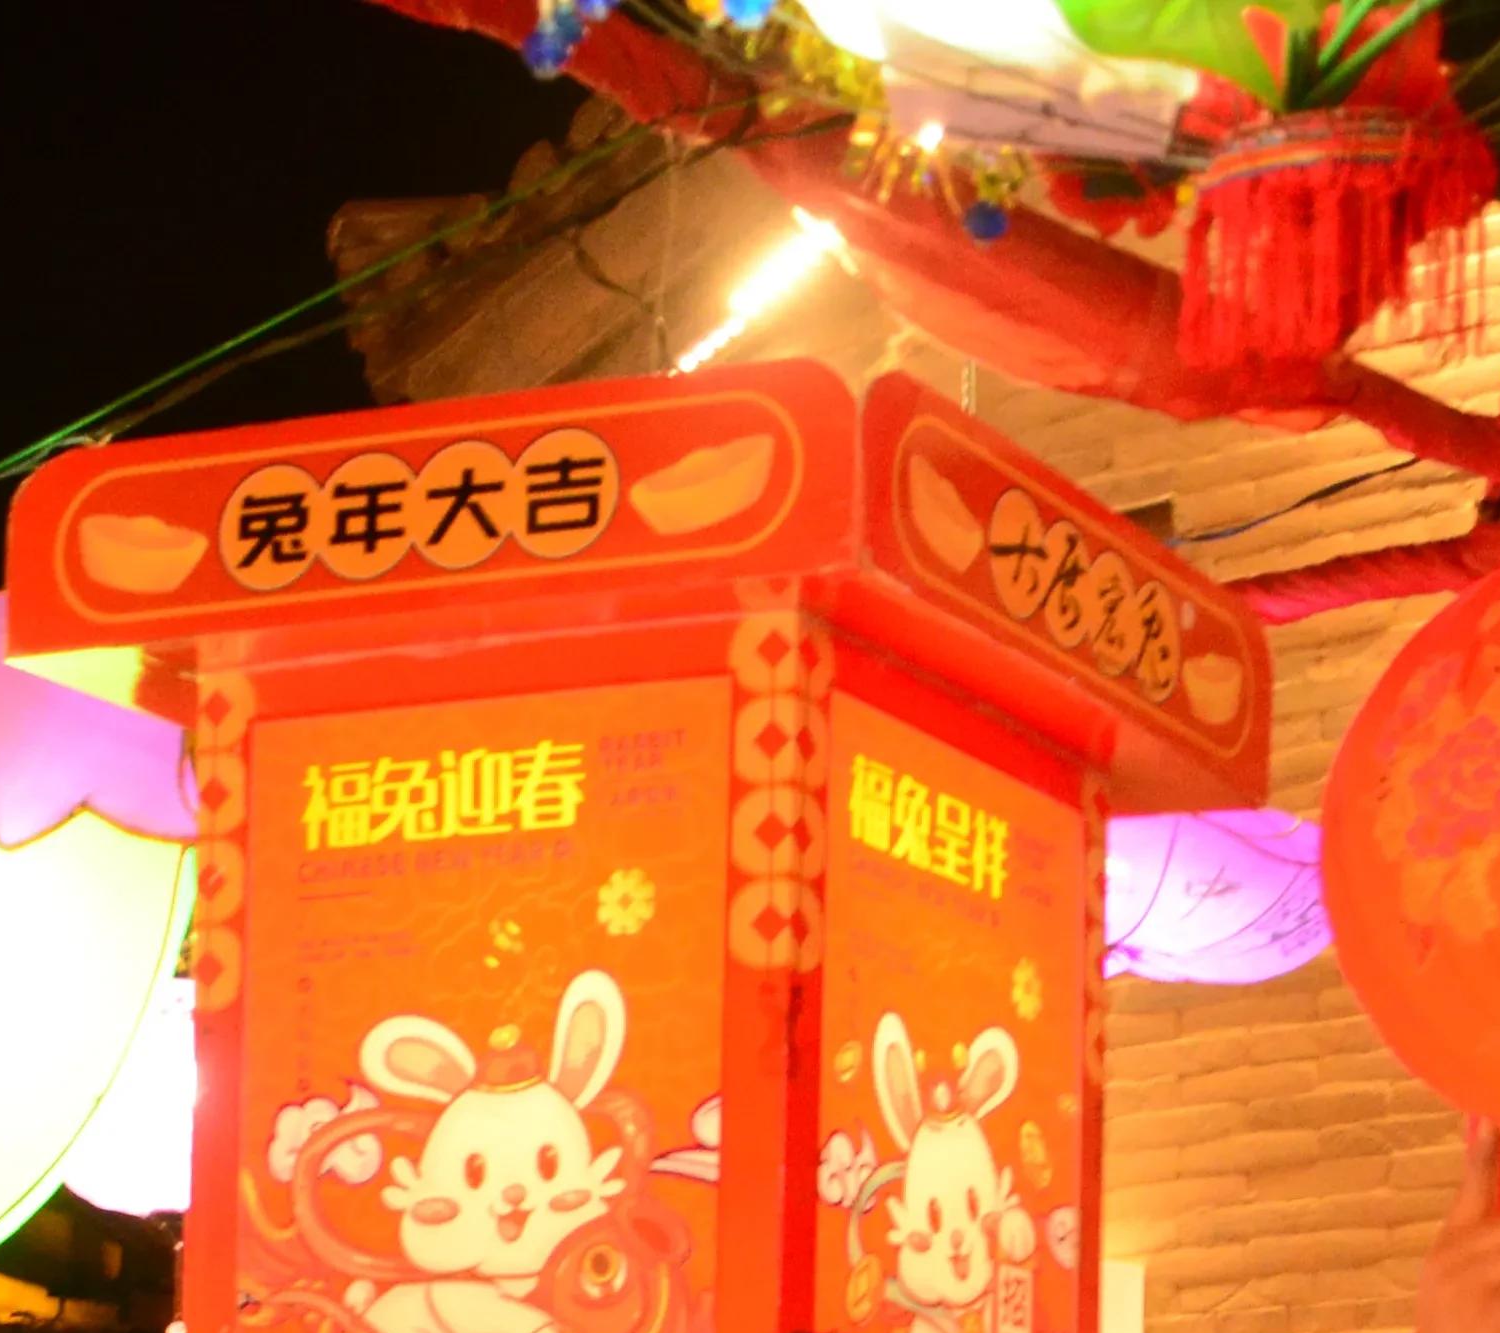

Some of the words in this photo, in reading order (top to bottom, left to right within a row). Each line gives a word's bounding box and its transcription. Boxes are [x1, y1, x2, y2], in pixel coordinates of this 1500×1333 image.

[234, 455, 606, 568] 兔年大吉
[300, 739, 587, 853] 福兔迎春
[848, 753, 1010, 901] 福兔呈祥
